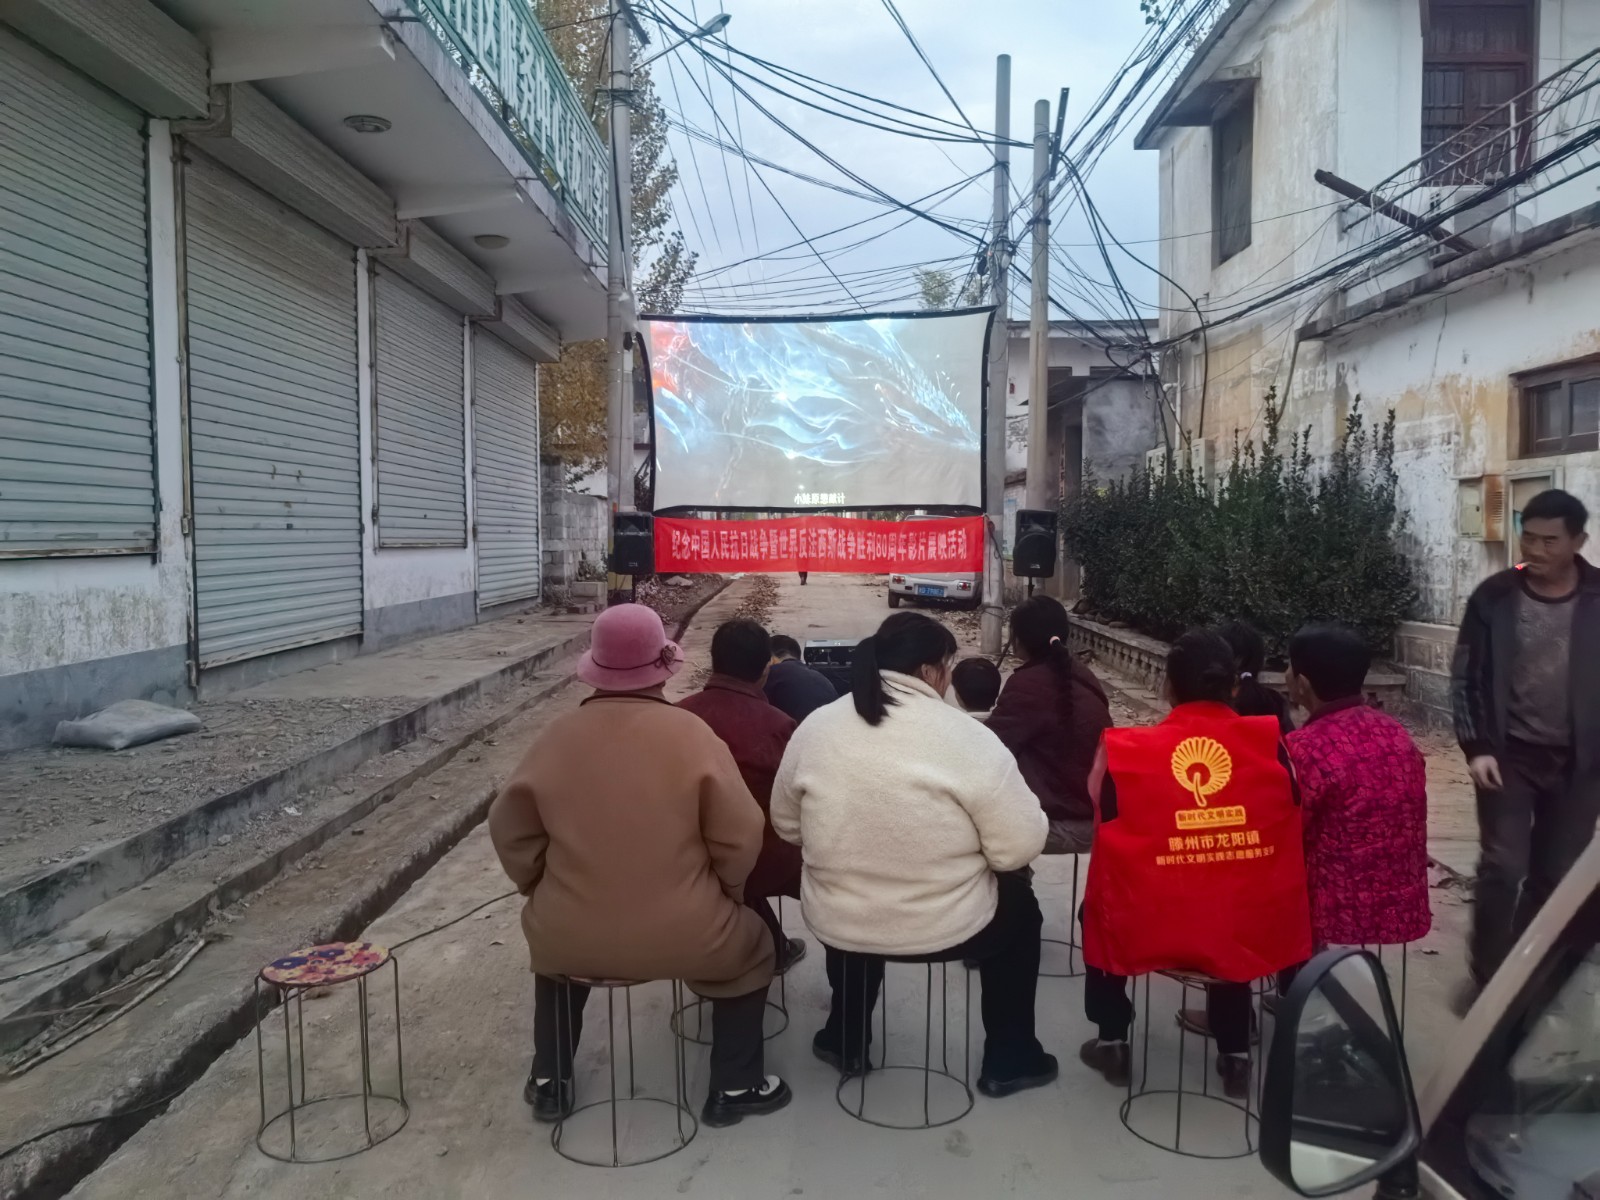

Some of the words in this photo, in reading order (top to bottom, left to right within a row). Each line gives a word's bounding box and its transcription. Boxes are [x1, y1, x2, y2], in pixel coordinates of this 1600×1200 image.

[671, 527, 968, 562] 纪念中国人民抗日战争暨世界反法西斯战争胜利80周年影片展映活动
[1177, 808, 1244, 822] 新时代文明实践
[1168, 830, 1260, 852] 滕州市龙阳镇
